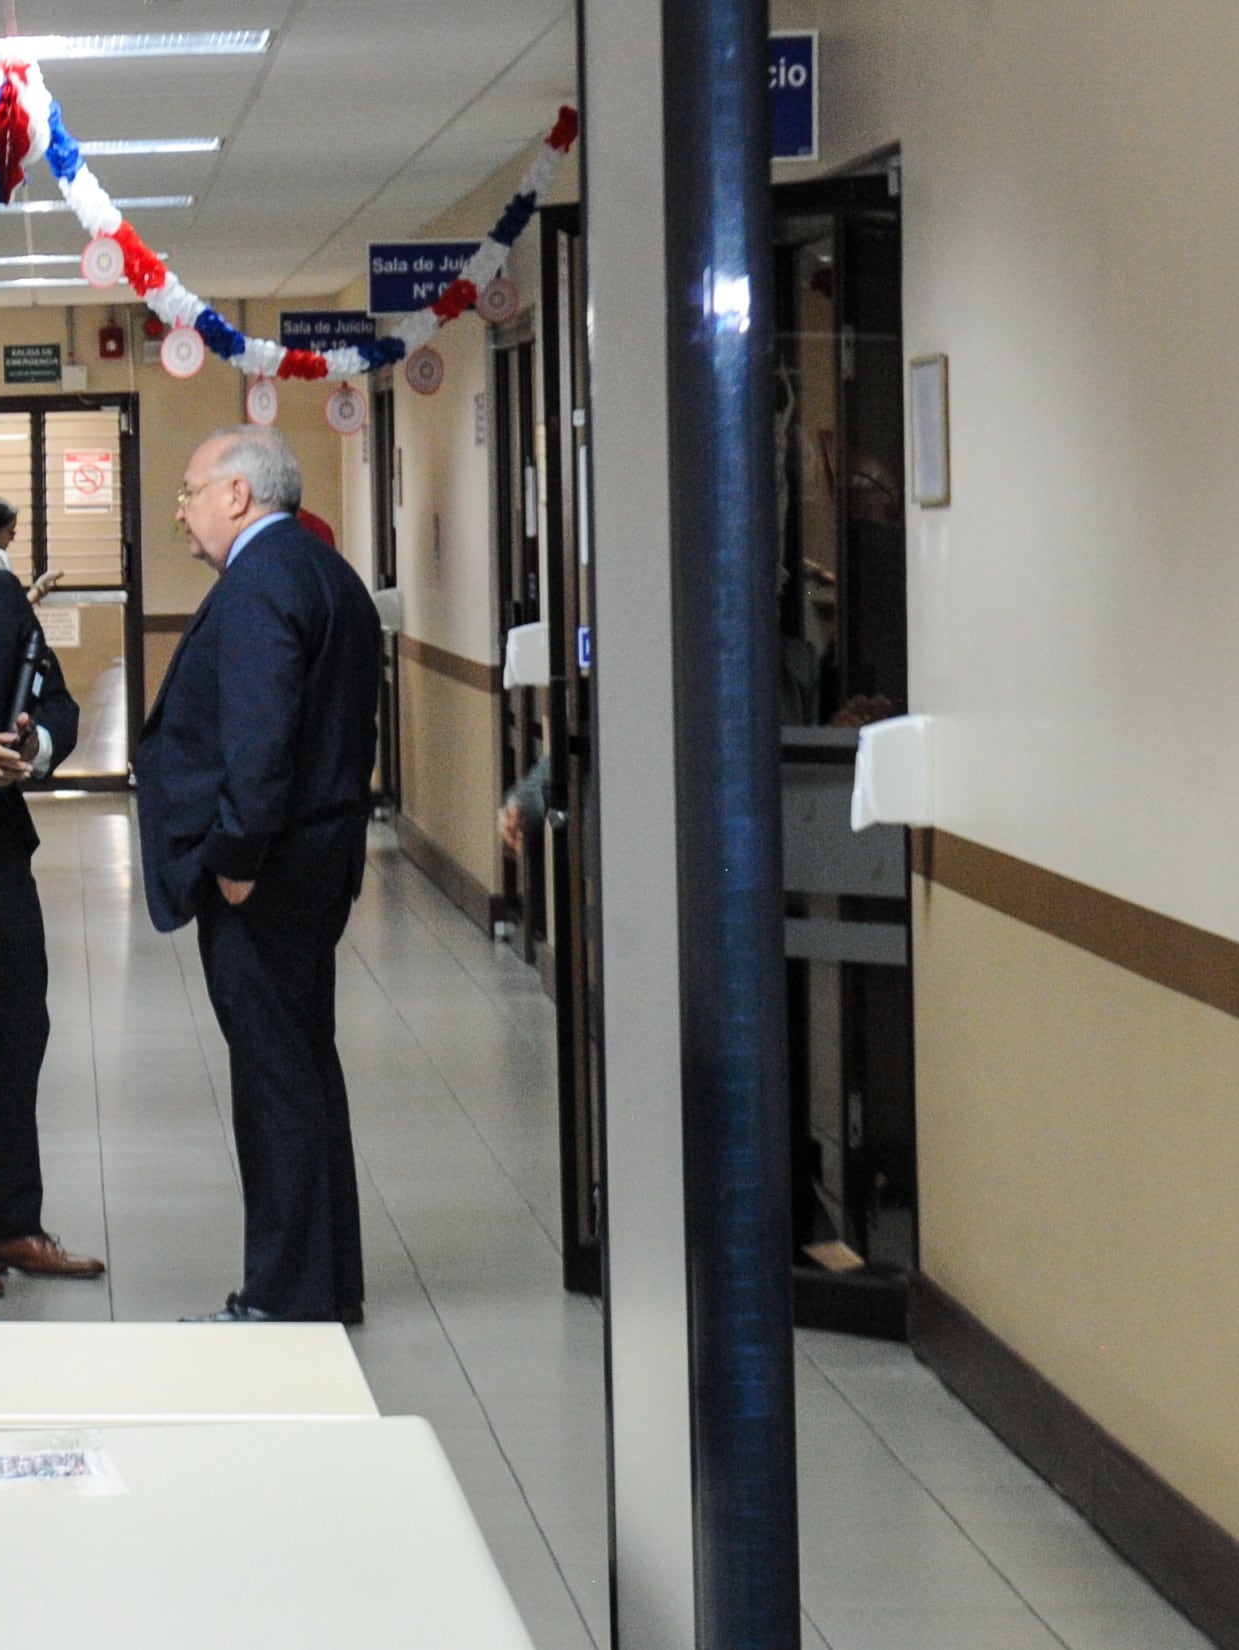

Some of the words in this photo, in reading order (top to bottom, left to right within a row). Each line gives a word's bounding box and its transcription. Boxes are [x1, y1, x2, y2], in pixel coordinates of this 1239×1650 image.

[372, 258, 409, 274] Sala
[413, 255, 434, 272] de
[283, 320, 311, 335] Sala
[314, 320, 331, 334] de
